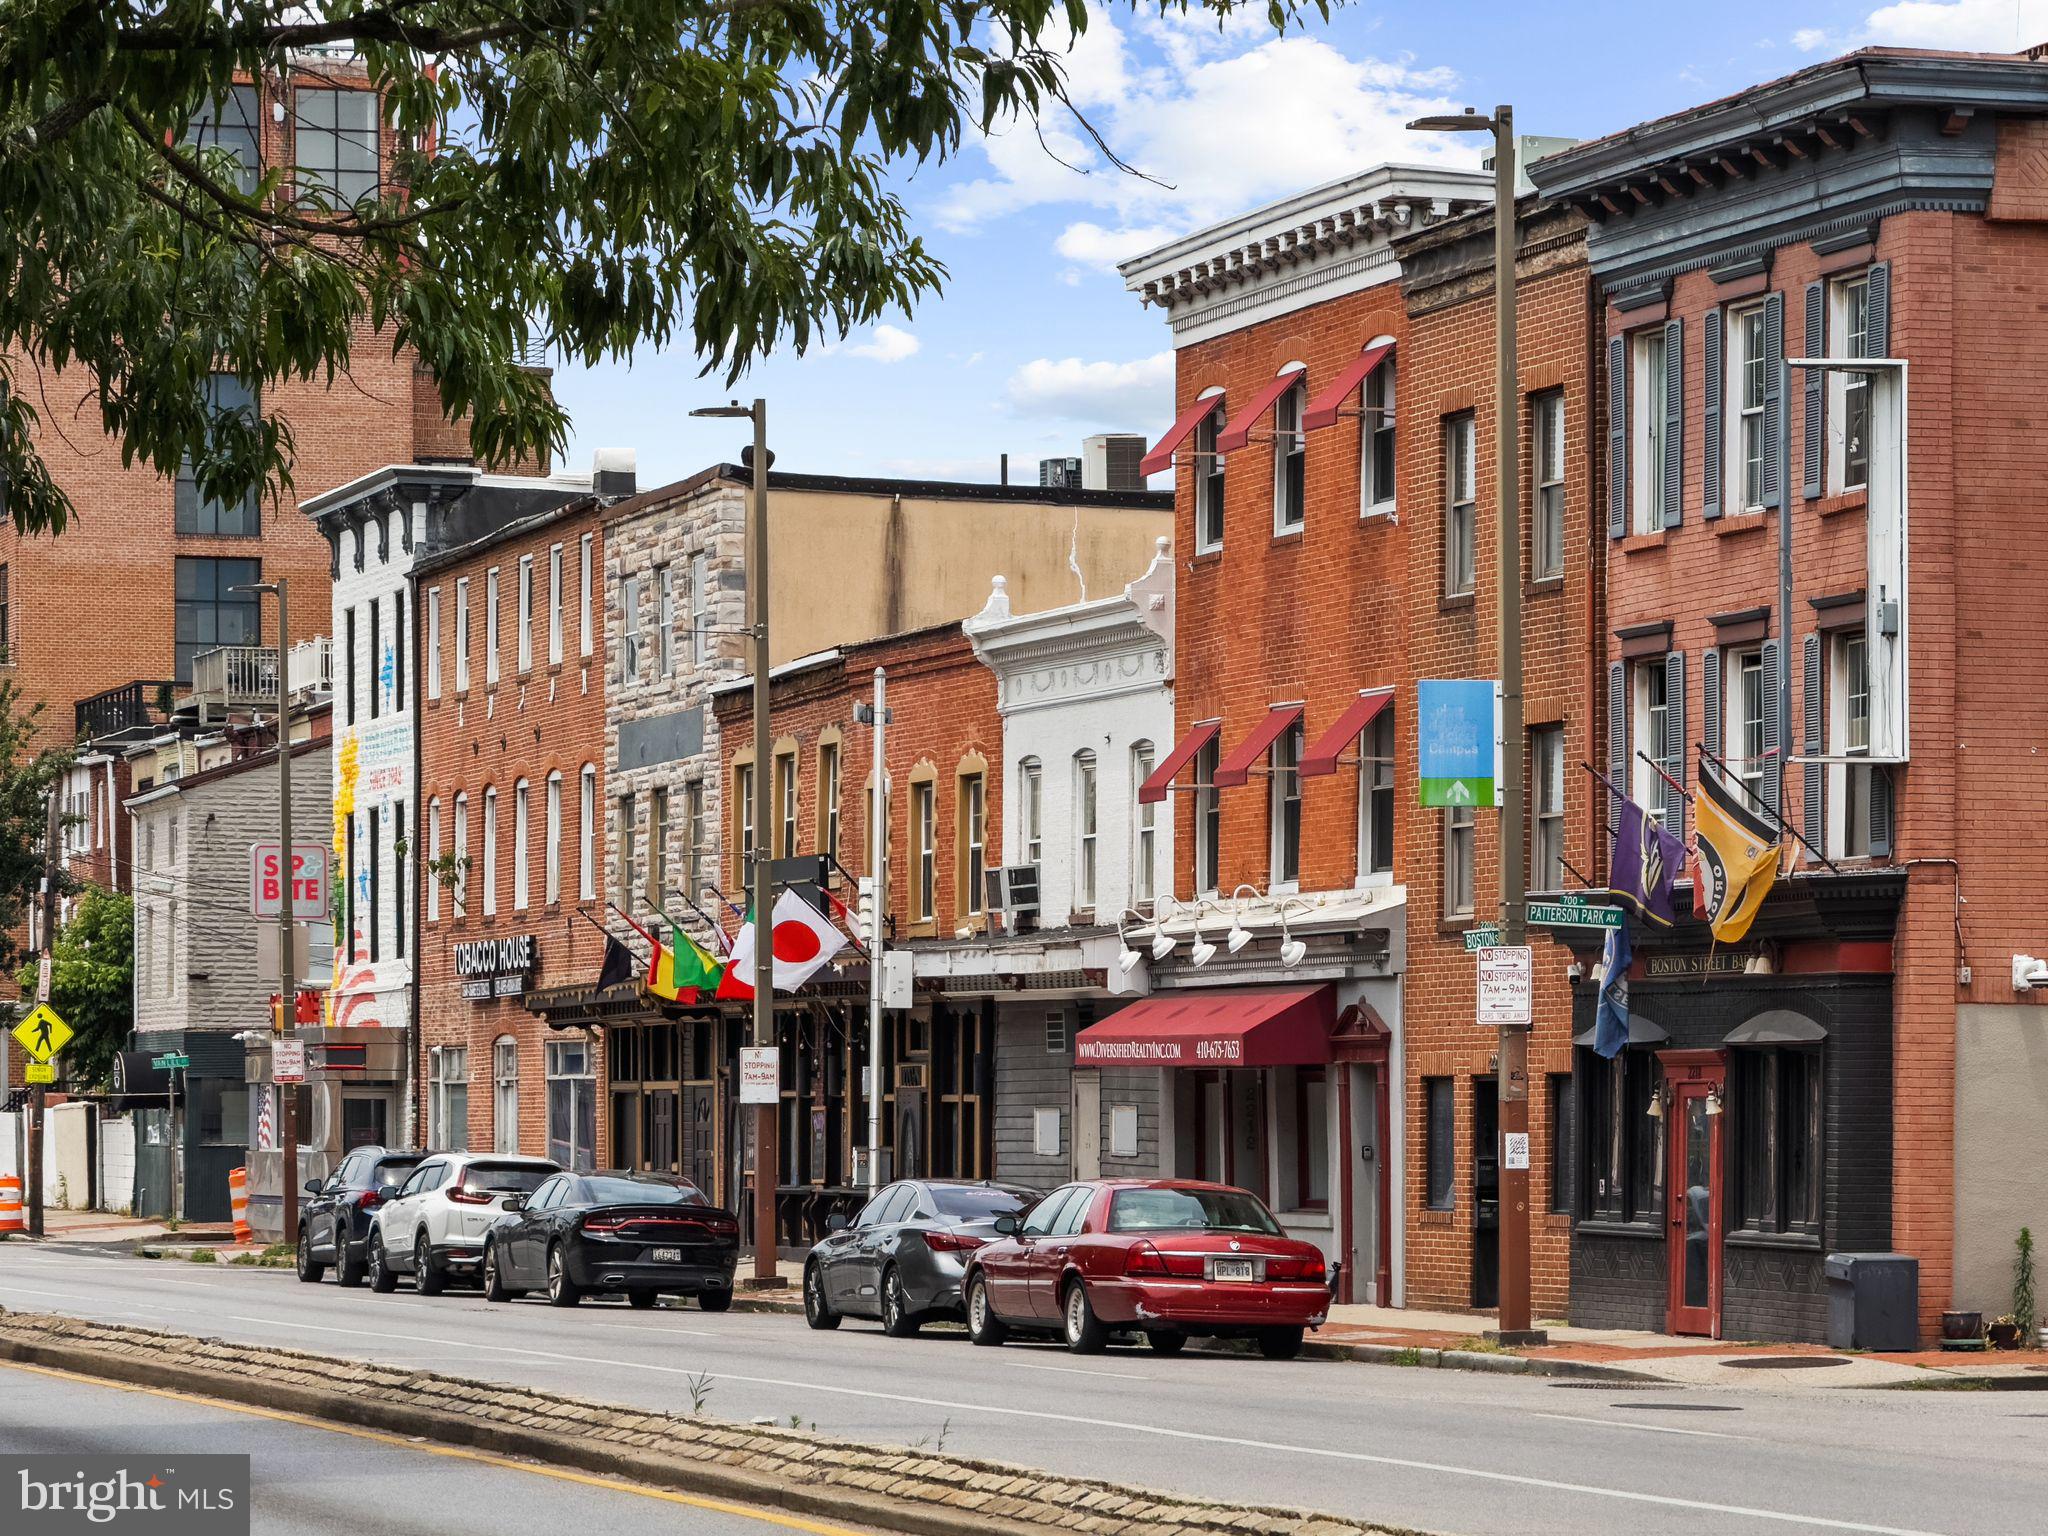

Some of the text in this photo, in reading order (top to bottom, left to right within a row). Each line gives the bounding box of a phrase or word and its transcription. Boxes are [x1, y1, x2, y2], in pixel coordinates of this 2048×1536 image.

[263, 878, 319, 900] BTE
[1563, 896, 1578, 905] 700
[1530, 906, 1579, 922] PATTERSON
[1581, 909, 1604, 924] PARK
[1466, 931, 1496, 949] BOSTON
[453, 935, 531, 975] TOBACCO HOUSE
[1480, 950, 1527, 961] NO STOPPING
[1651, 958, 1687, 974] BOSTON
[1691, 955, 1728, 972] STREET
[1480, 971, 1527, 982] NO STOPPING
[1196, 1040, 1240, 1059] 410-675-7653
